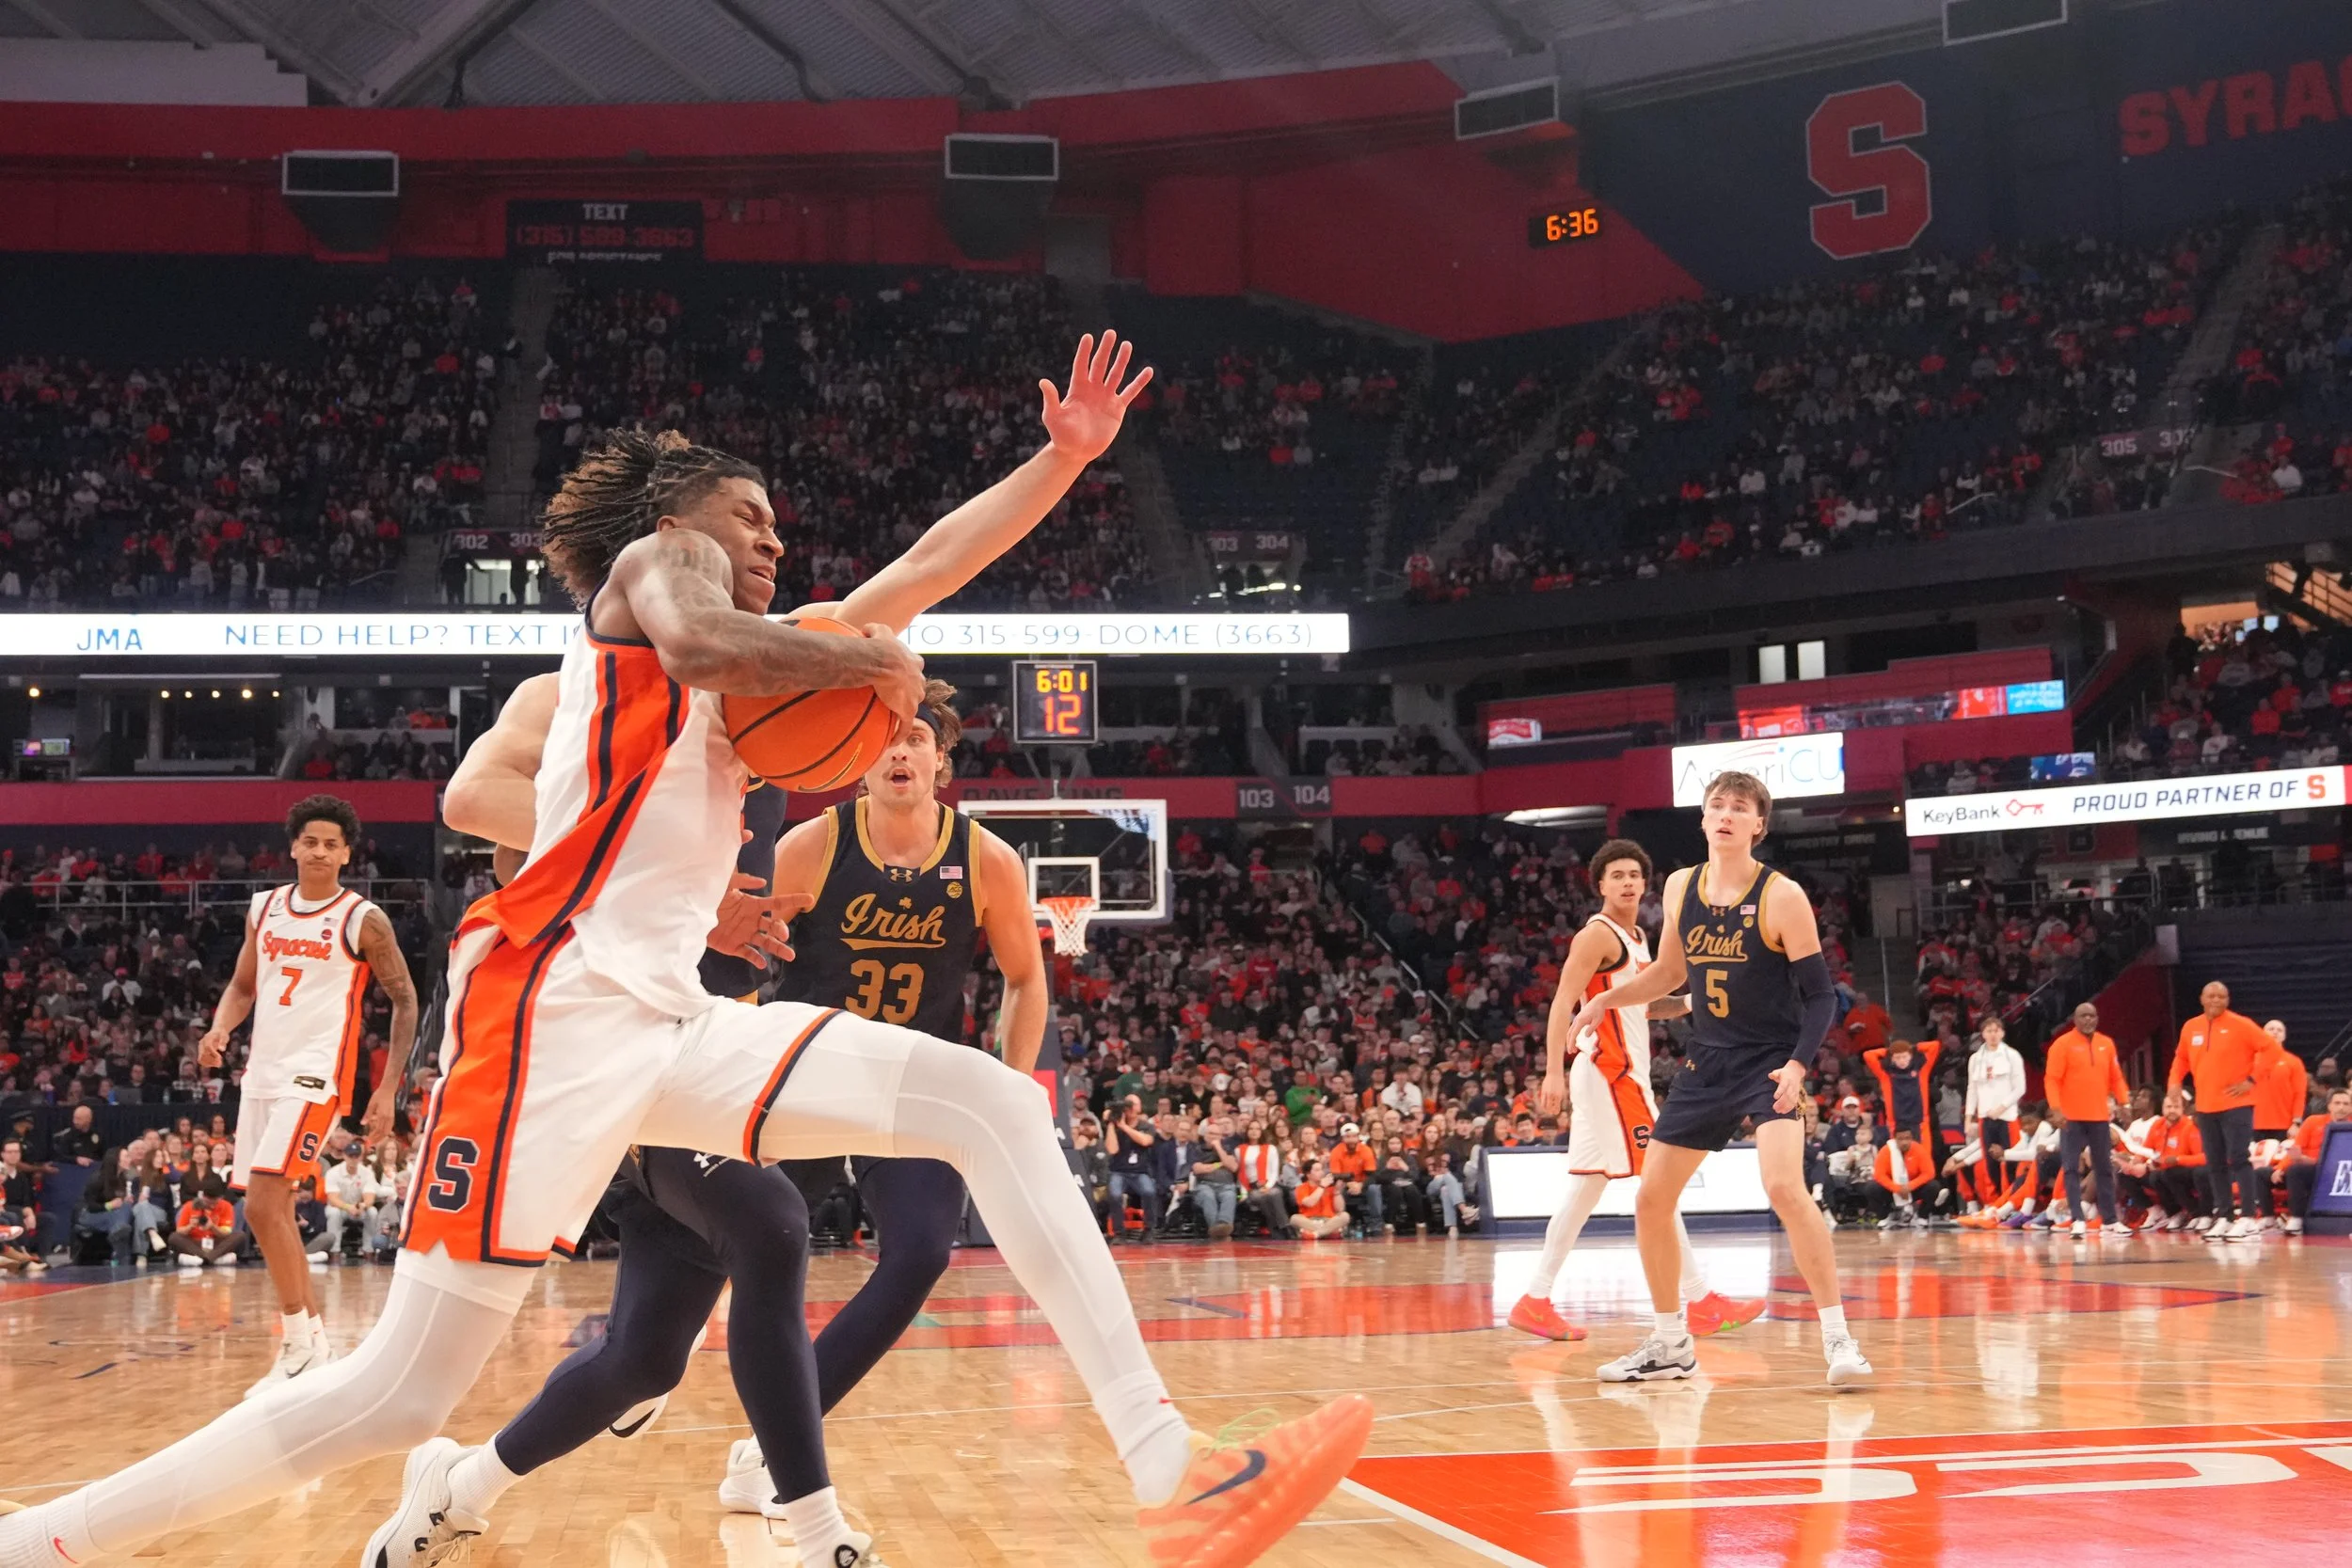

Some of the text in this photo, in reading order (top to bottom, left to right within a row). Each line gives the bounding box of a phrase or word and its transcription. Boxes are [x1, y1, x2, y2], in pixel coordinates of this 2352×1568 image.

[2119, 55, 2352, 155] SYRA
[1805, 80, 1931, 261] S
[582, 203, 628, 221] TEXT
[1546, 208, 1598, 241] 6:36
[2101, 438, 2137, 456] 305
[1256, 534, 1289, 549] 304
[77, 628, 143, 651] JMA
[227, 625, 323, 645] NEED
[338, 625, 447, 646] HELP?
[466, 625, 547, 645] TEXT
[906, 625, 944, 645] TO
[1216, 623, 1311, 648] (3663)
[1037, 669, 1088, 693] 6:01
[1044, 694, 1082, 735] 12
[1239, 784, 1330, 808] 103 104
[2073, 774, 2327, 814] PROUD PARTNER OF S
[1923, 806, 2001, 825] KeyBank
[840, 893, 947, 942] Irish
[262, 930, 333, 961] Syracuse
[1685, 925, 1747, 957] Irish
[278, 966, 304, 1006] 7
[845, 958, 924, 1024] 33
[1706, 969, 1730, 1018] 5
[299, 1132, 319, 1163] S
[1631, 1124, 1651, 1150] S
[425, 1135, 481, 1213] S
